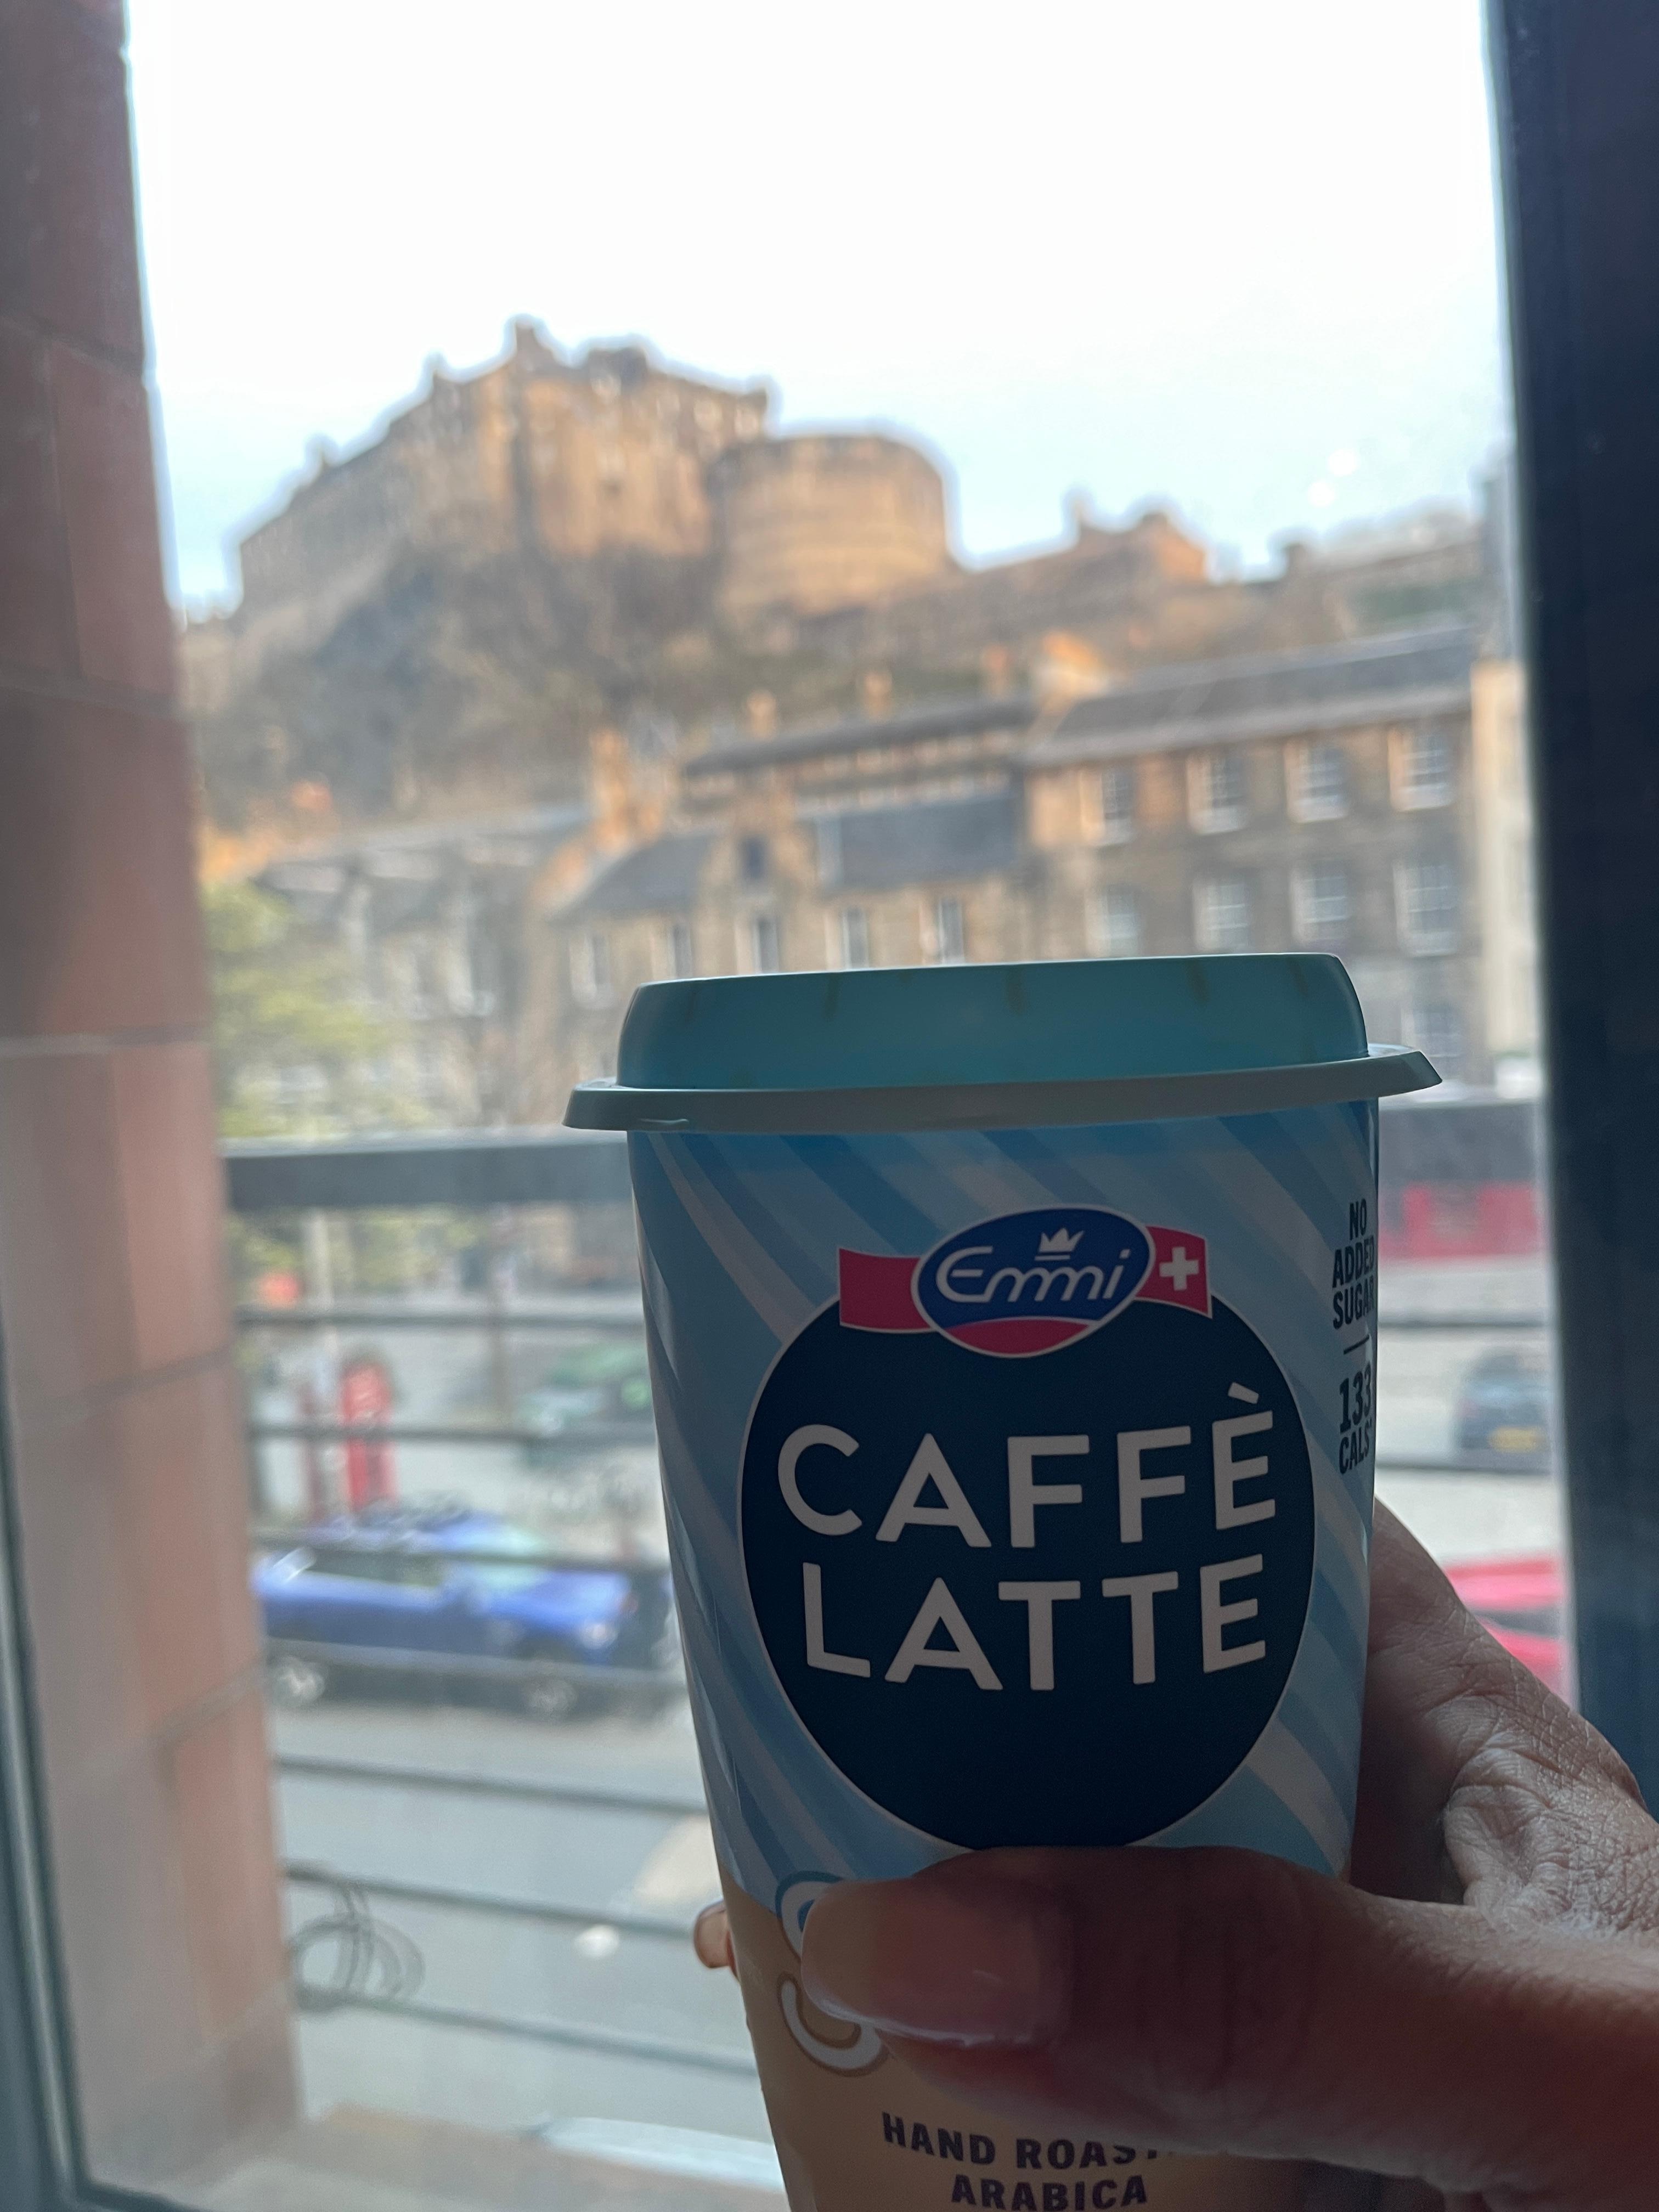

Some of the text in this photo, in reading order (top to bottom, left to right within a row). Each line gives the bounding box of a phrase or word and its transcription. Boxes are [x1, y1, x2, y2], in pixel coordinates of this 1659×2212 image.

[1349, 1198, 1367, 1240] NO
[936, 1246, 1130, 1304] Emmi
[1332, 1235, 1375, 1288] ADDED
[1333, 1275, 1375, 1330] SUGAR
[1339, 1362, 1372, 1432] 133
[777, 1382, 1276, 1549] CAFFÈ
[802, 1553, 1266, 1691] LATTE
[881, 2112, 1157, 2170] HAND ROAS
[951, 2174, 1147, 2212] ARABICA
